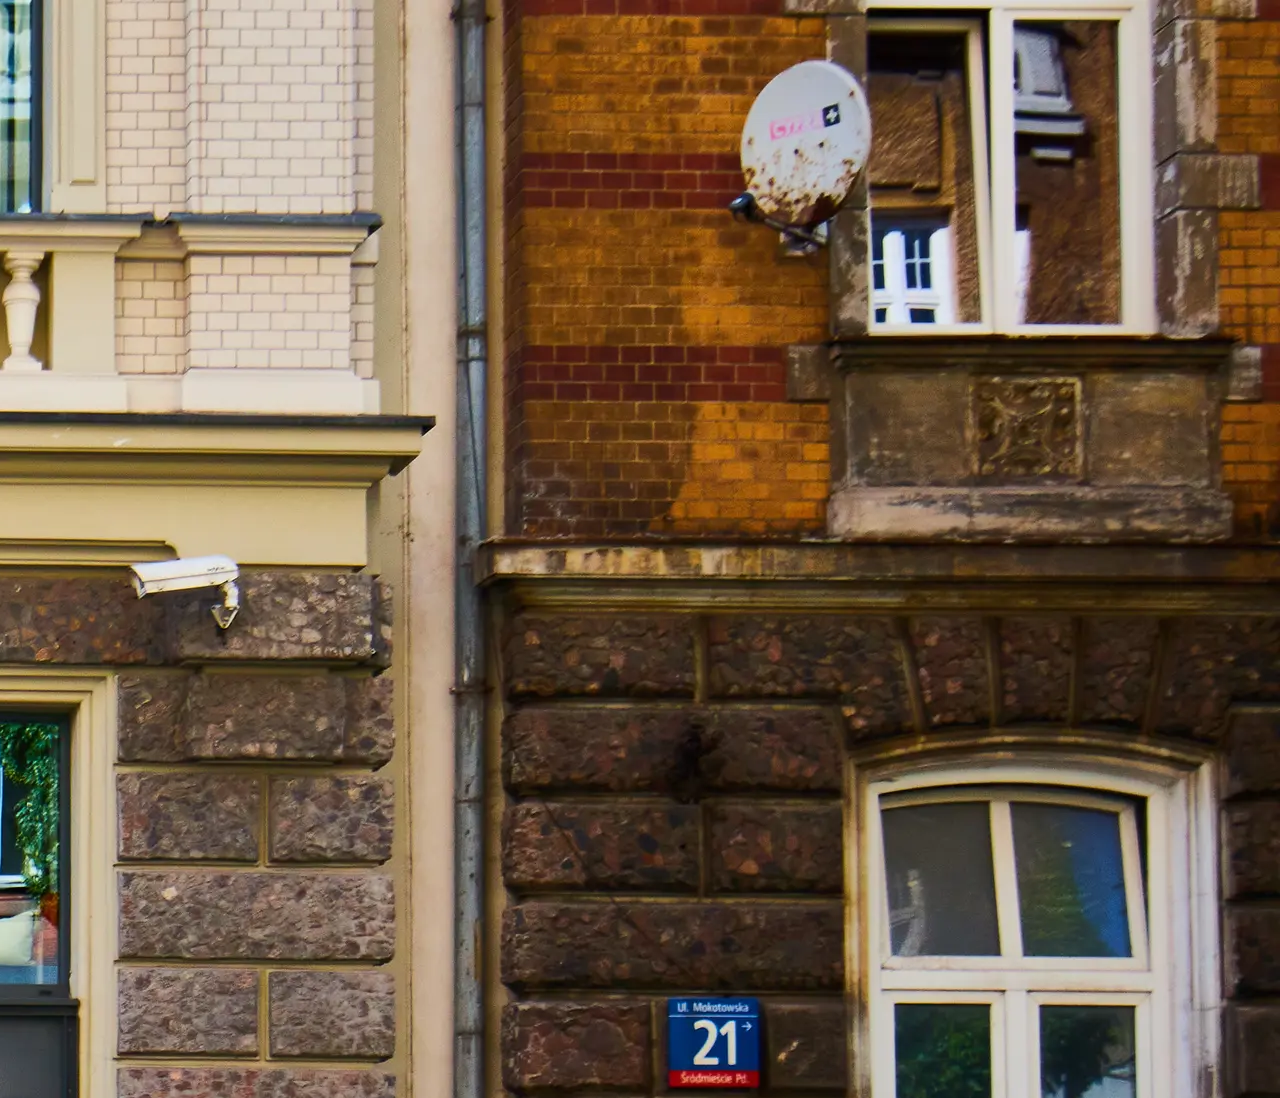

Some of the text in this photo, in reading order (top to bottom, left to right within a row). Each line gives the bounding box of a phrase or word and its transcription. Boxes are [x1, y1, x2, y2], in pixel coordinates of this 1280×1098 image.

[692, 1002, 750, 1013] Mokotowska
[693, 1019, 737, 1066] 21
[681, 1071, 733, 1084] Śródmieście
